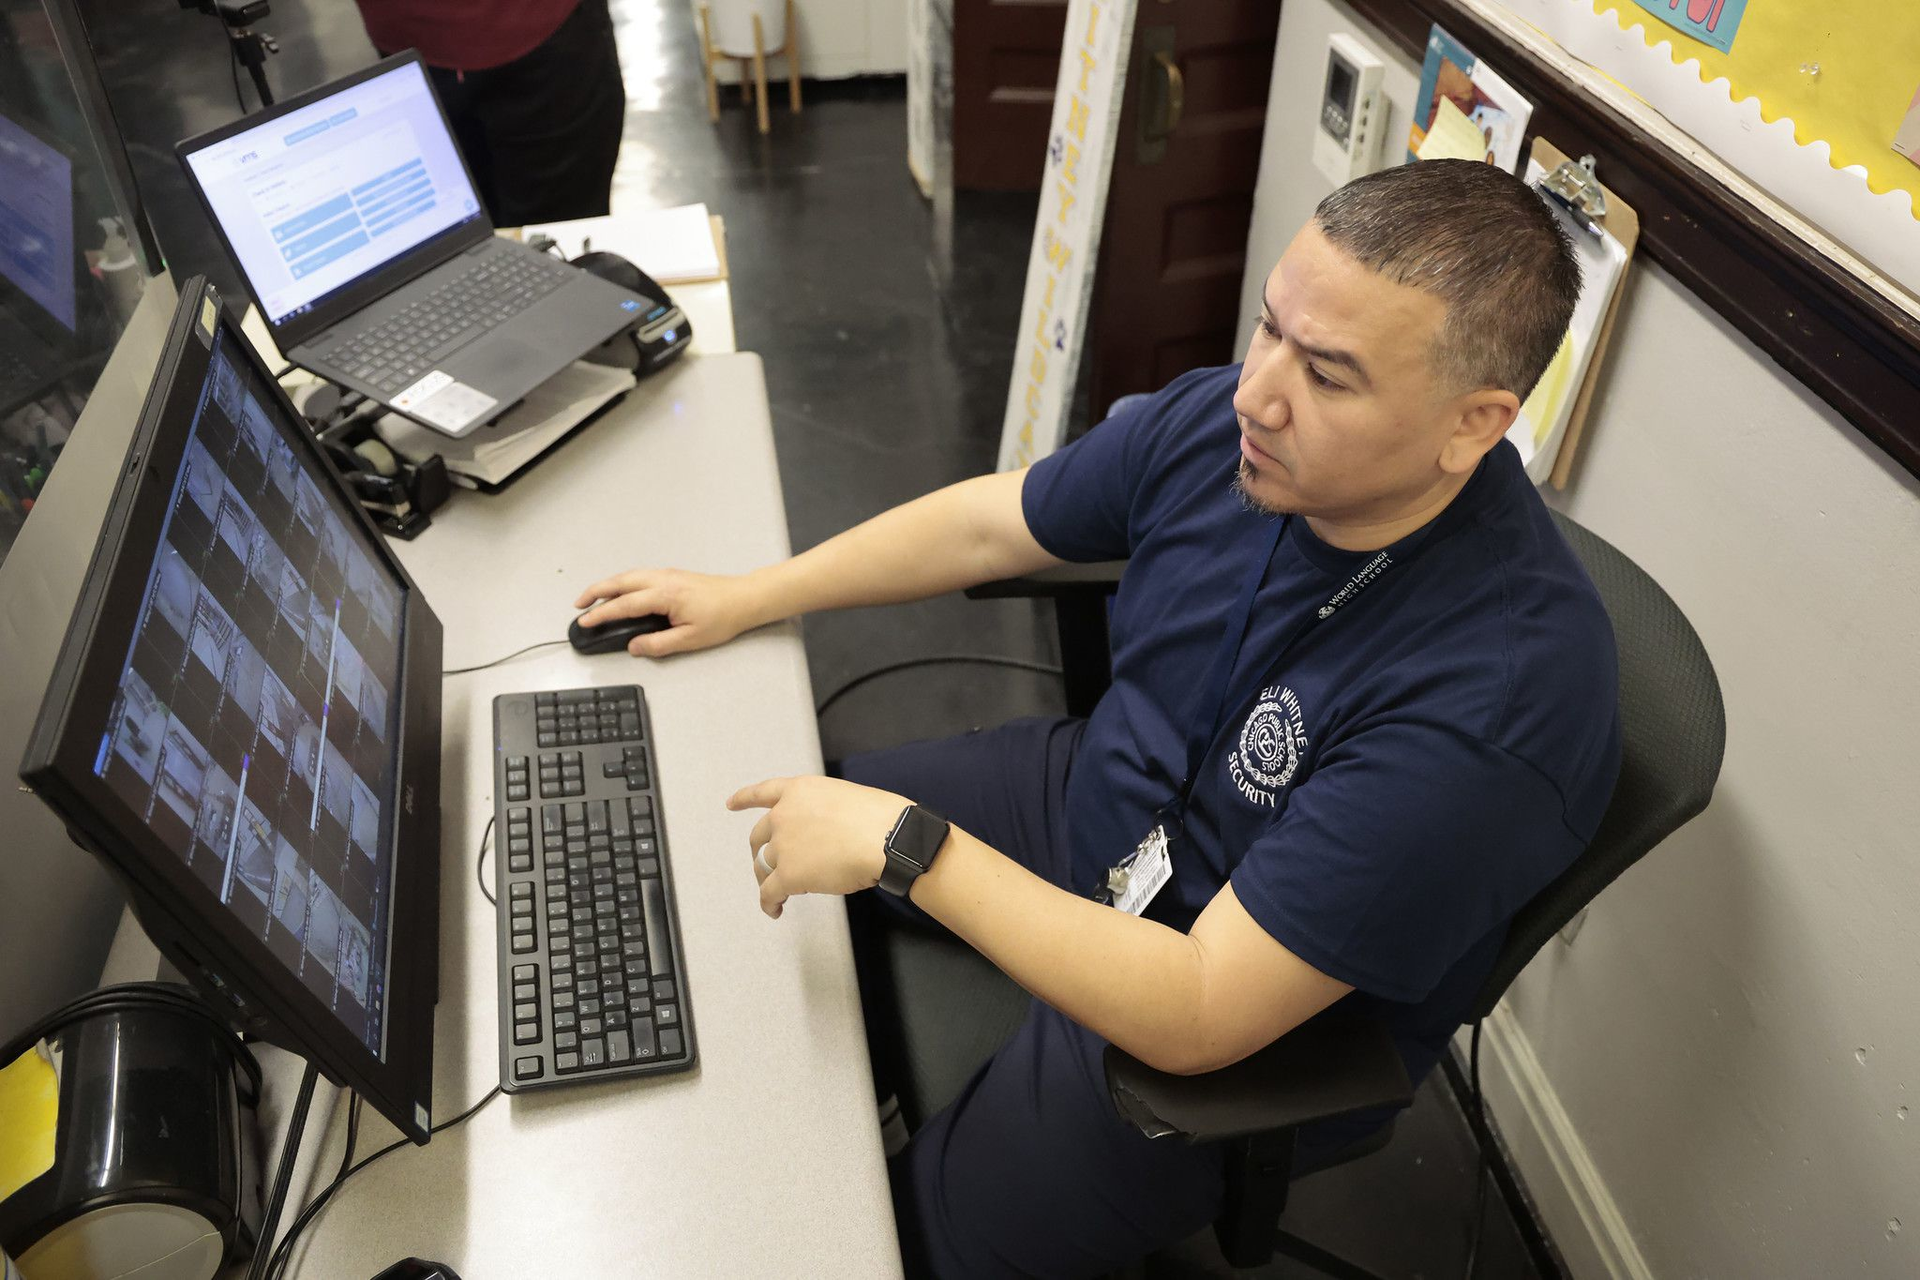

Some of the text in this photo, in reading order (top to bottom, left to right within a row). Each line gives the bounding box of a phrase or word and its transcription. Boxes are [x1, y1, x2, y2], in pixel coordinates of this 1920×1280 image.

[1056, 1, 1101, 226] ITNEY
[1329, 550, 1388, 605] WORLD LANGUAGE
[1359, 558, 1393, 588] SCHOOL
[1247, 713, 1286, 772] CHICAGO PUBLIC SCHOOLS
[1260, 685, 1308, 755] ELI WHITNE
[1228, 751, 1275, 808] SECURITY
